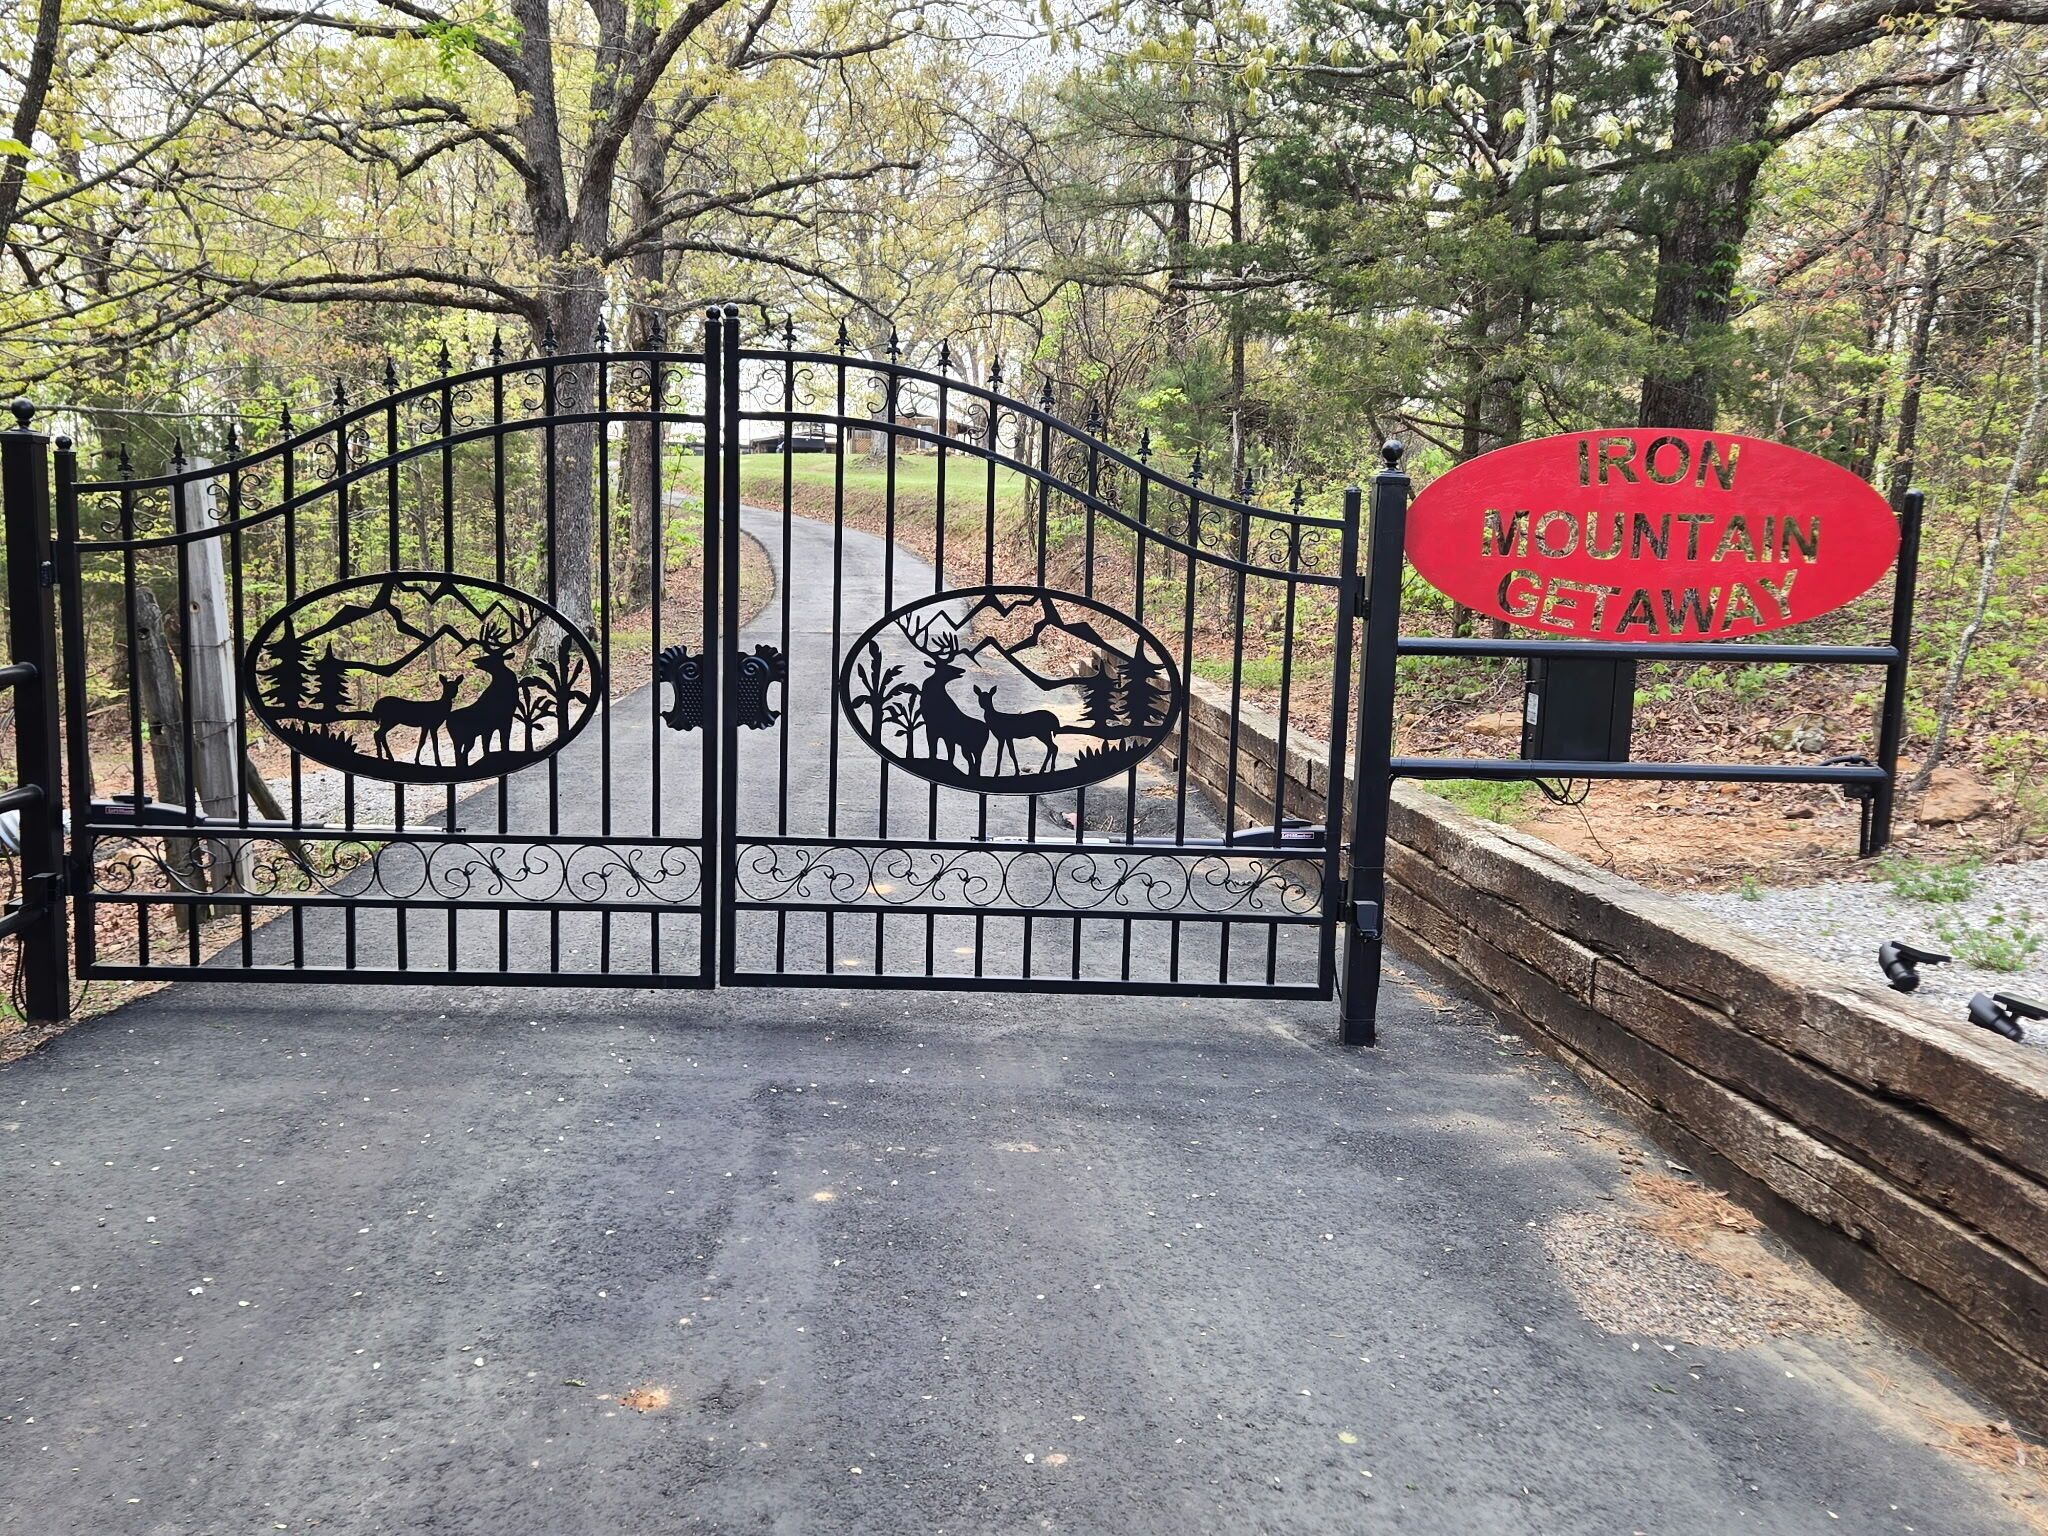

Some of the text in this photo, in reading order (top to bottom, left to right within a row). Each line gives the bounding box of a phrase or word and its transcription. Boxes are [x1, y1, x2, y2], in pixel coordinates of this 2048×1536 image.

[1579, 436, 1740, 491] IRON
[1482, 509, 1820, 563] MOUNTAIN
[1497, 568, 1798, 635] GETAWAY
